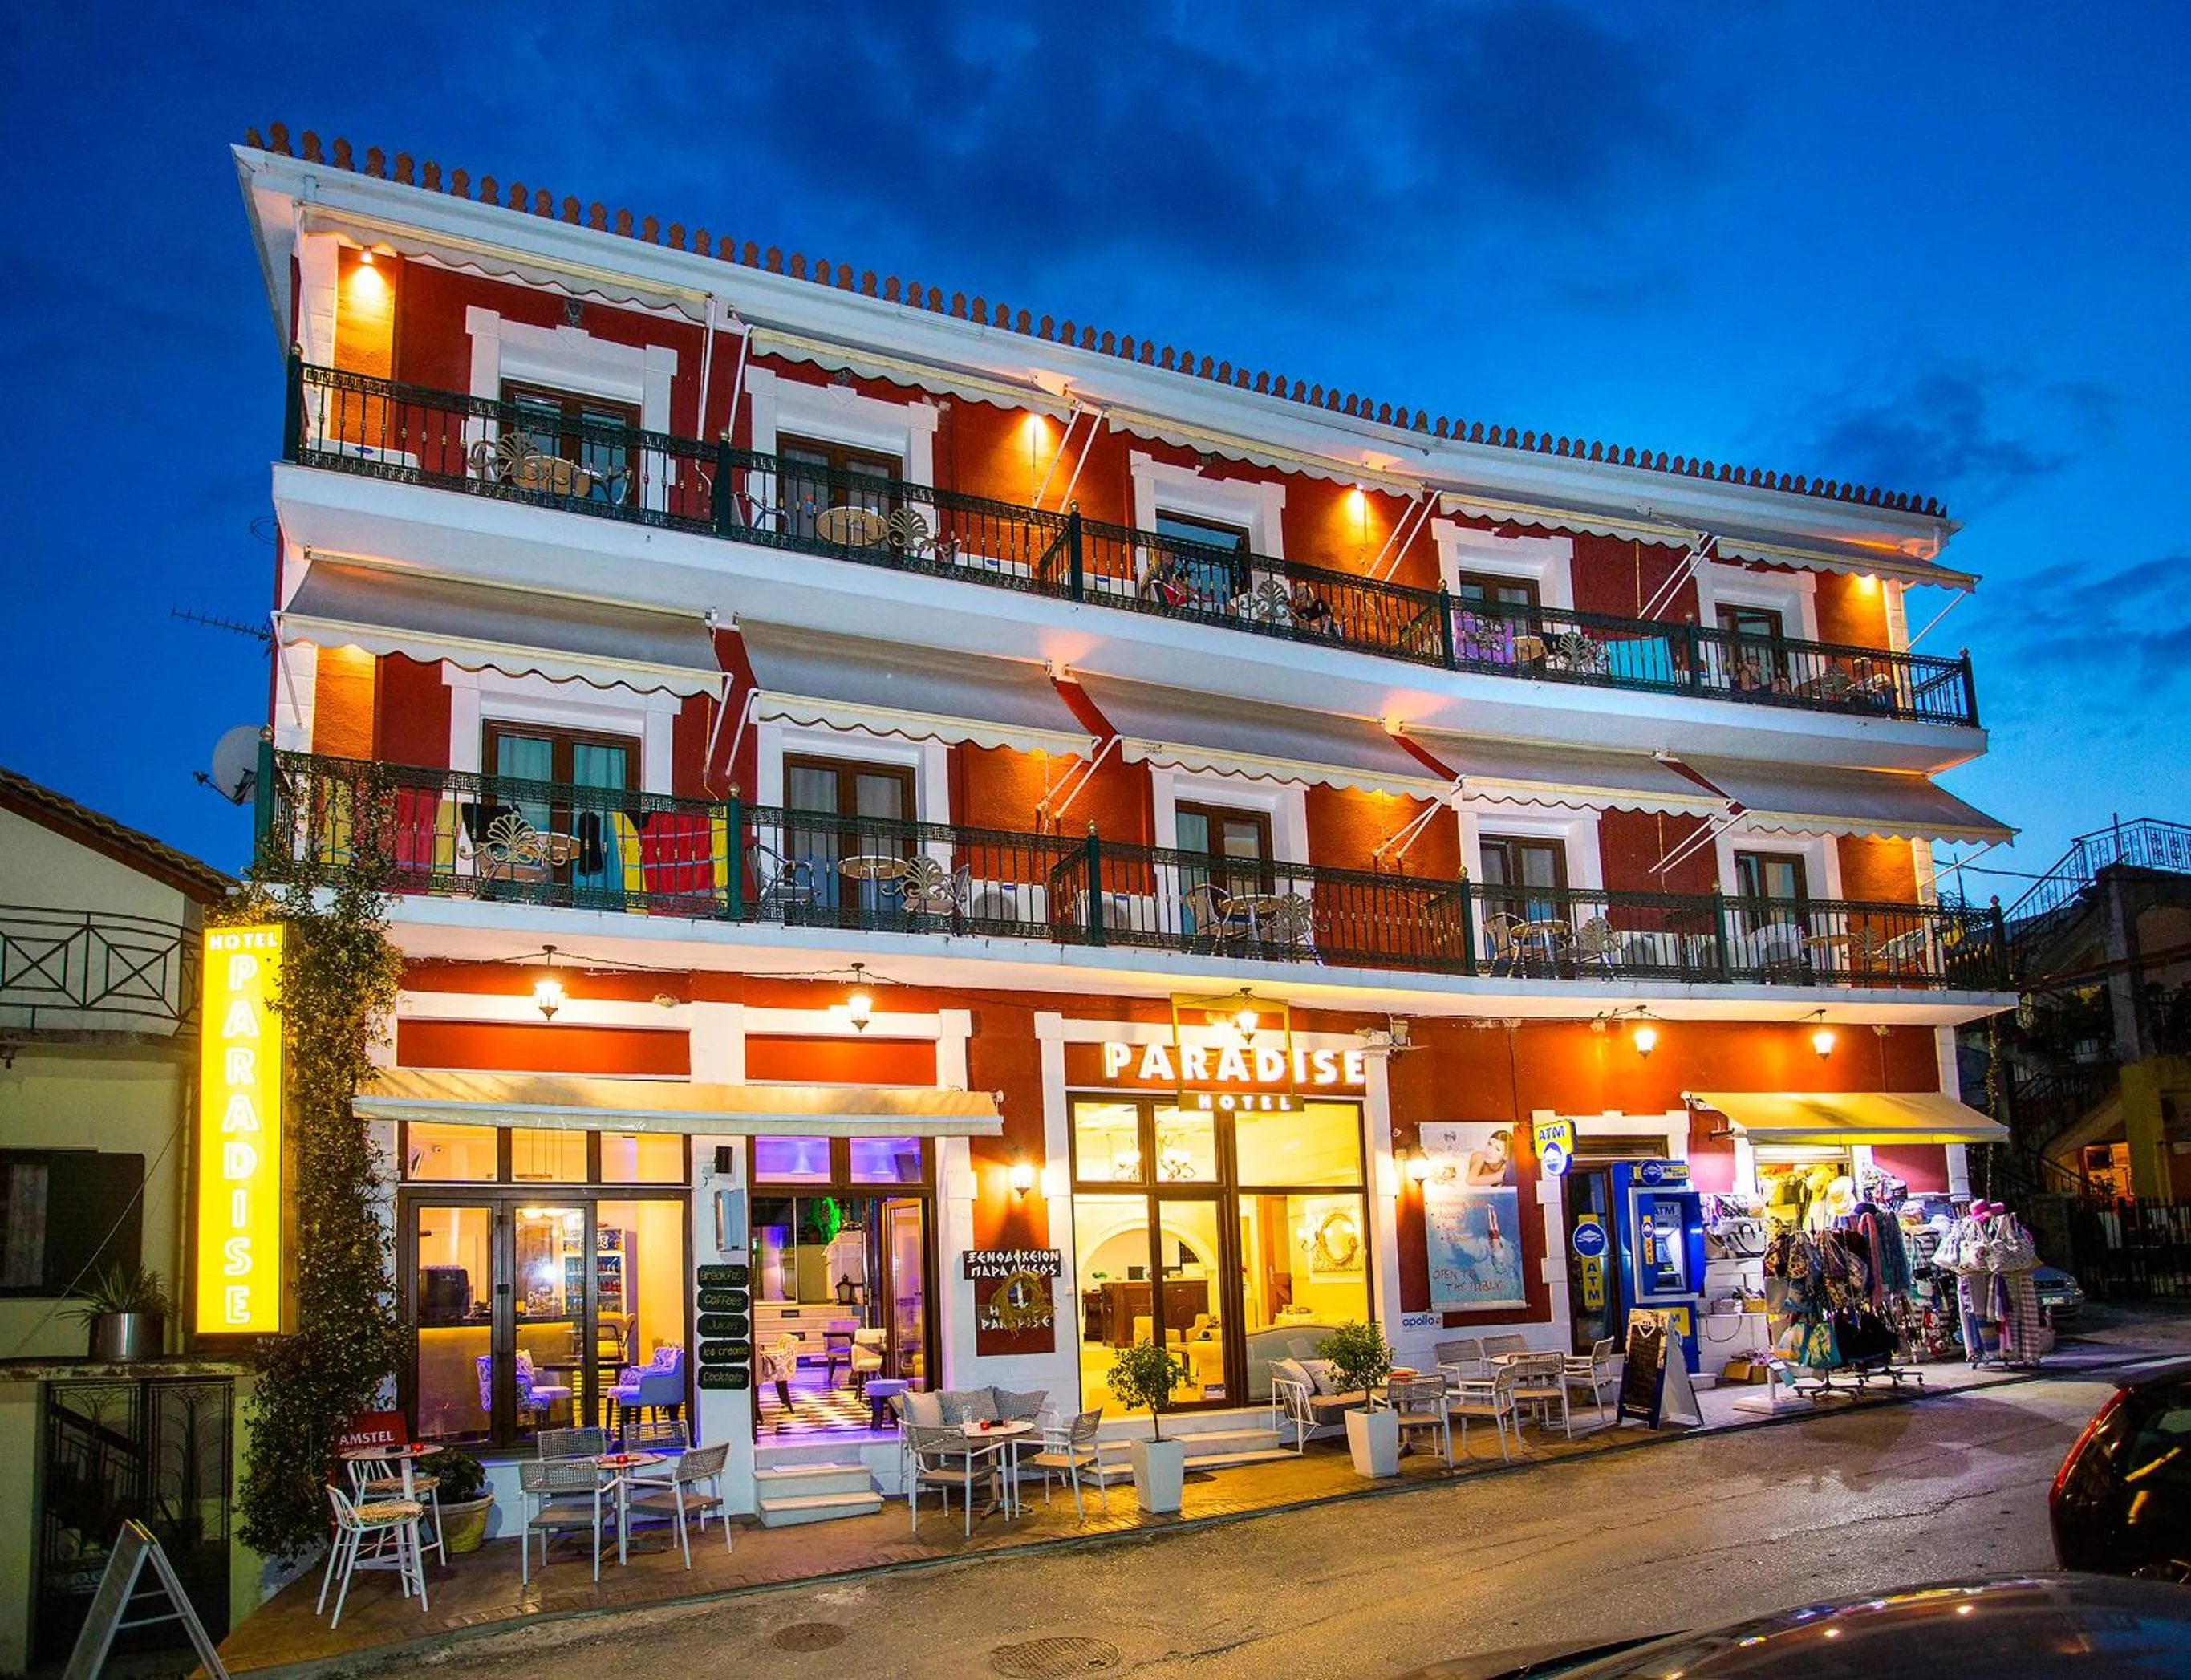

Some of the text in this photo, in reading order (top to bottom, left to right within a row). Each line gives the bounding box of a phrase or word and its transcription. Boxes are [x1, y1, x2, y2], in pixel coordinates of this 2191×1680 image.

[209, 931, 278, 950] HOTEL
[1103, 1041, 1366, 1085] PARADISE
[1197, 1094, 1291, 1111] HOTEL
[221, 953, 260, 1325] PARADISE
[1539, 1125, 1565, 1140] ATM
[1587, 1263, 1601, 1301] ATM
[1402, 1313, 1435, 1328] apollo
[339, 1430, 396, 1446] AMSTEL
